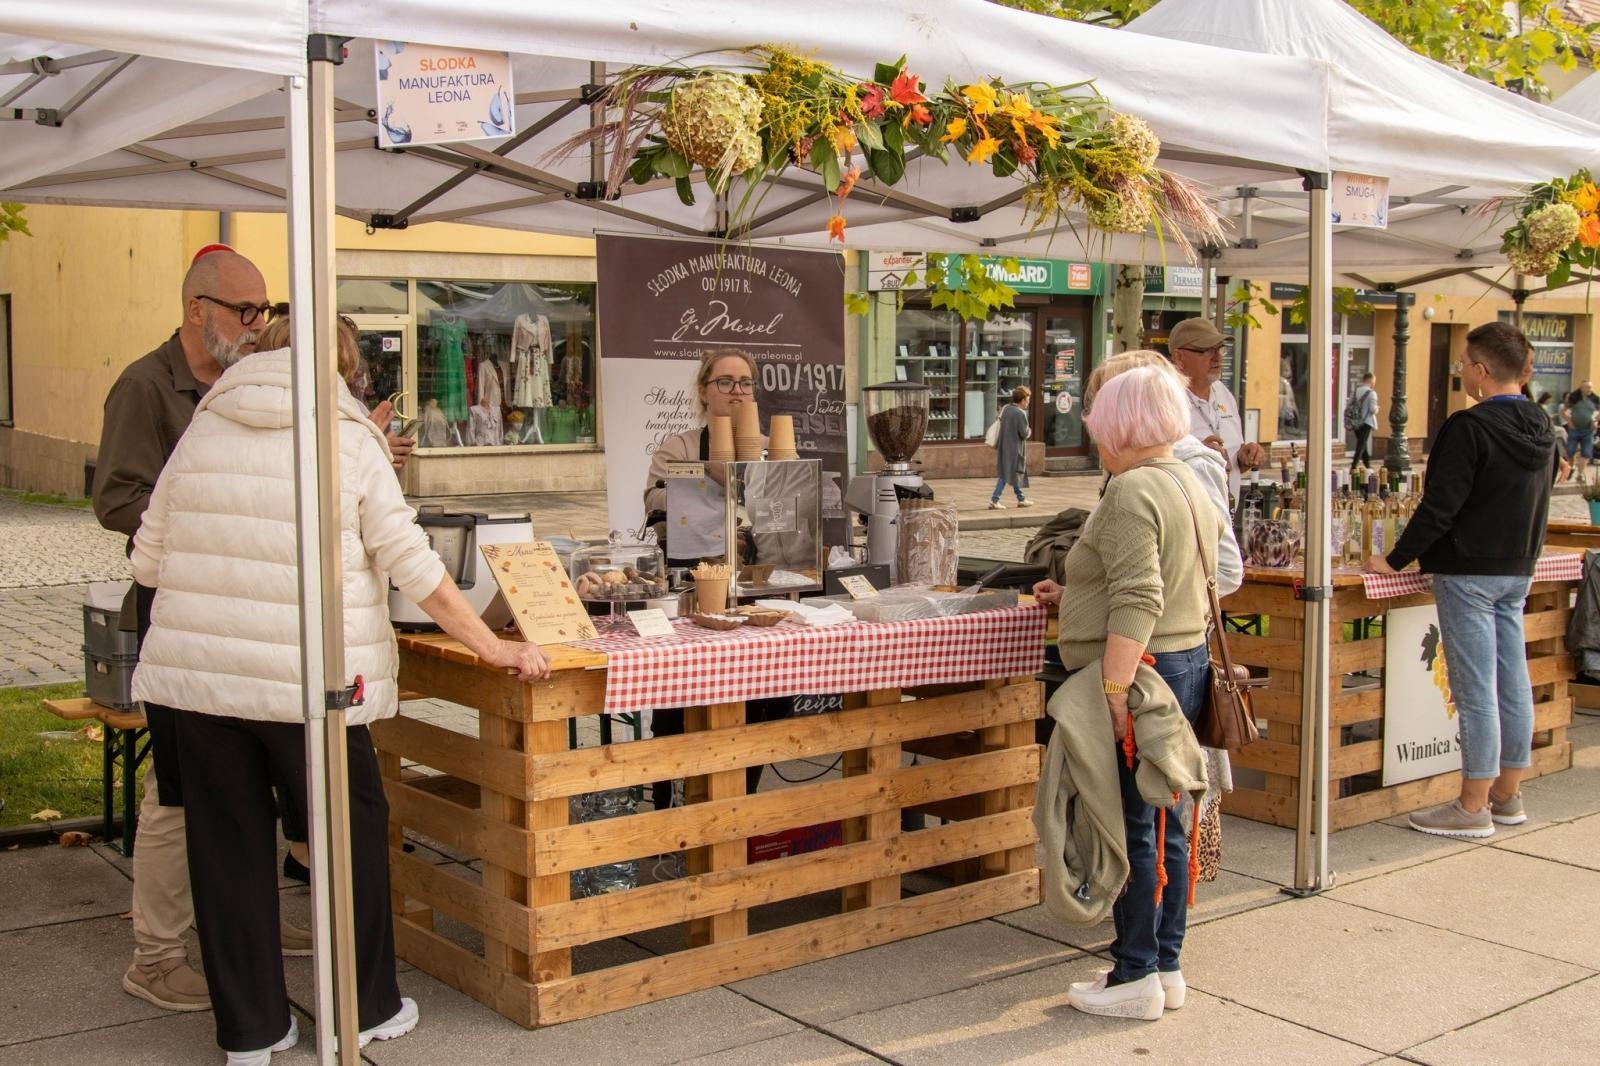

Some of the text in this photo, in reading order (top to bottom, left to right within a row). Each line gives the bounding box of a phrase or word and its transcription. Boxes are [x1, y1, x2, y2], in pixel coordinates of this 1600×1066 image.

[419, 57, 477, 71] SŁODKA
[399, 73, 495, 90] MANUFAKTURA
[428, 89, 471, 104] LEONA
[1345, 185, 1375, 198] SMUGA
[647, 253, 803, 297] SŁODKA MANUFAKTURA LEONA
[701, 276, 753, 294] OD 1917 R.
[1519, 318, 1568, 338] KANTOR
[762, 362, 845, 392] OD/1917
[1396, 737, 1451, 764] Winnica
